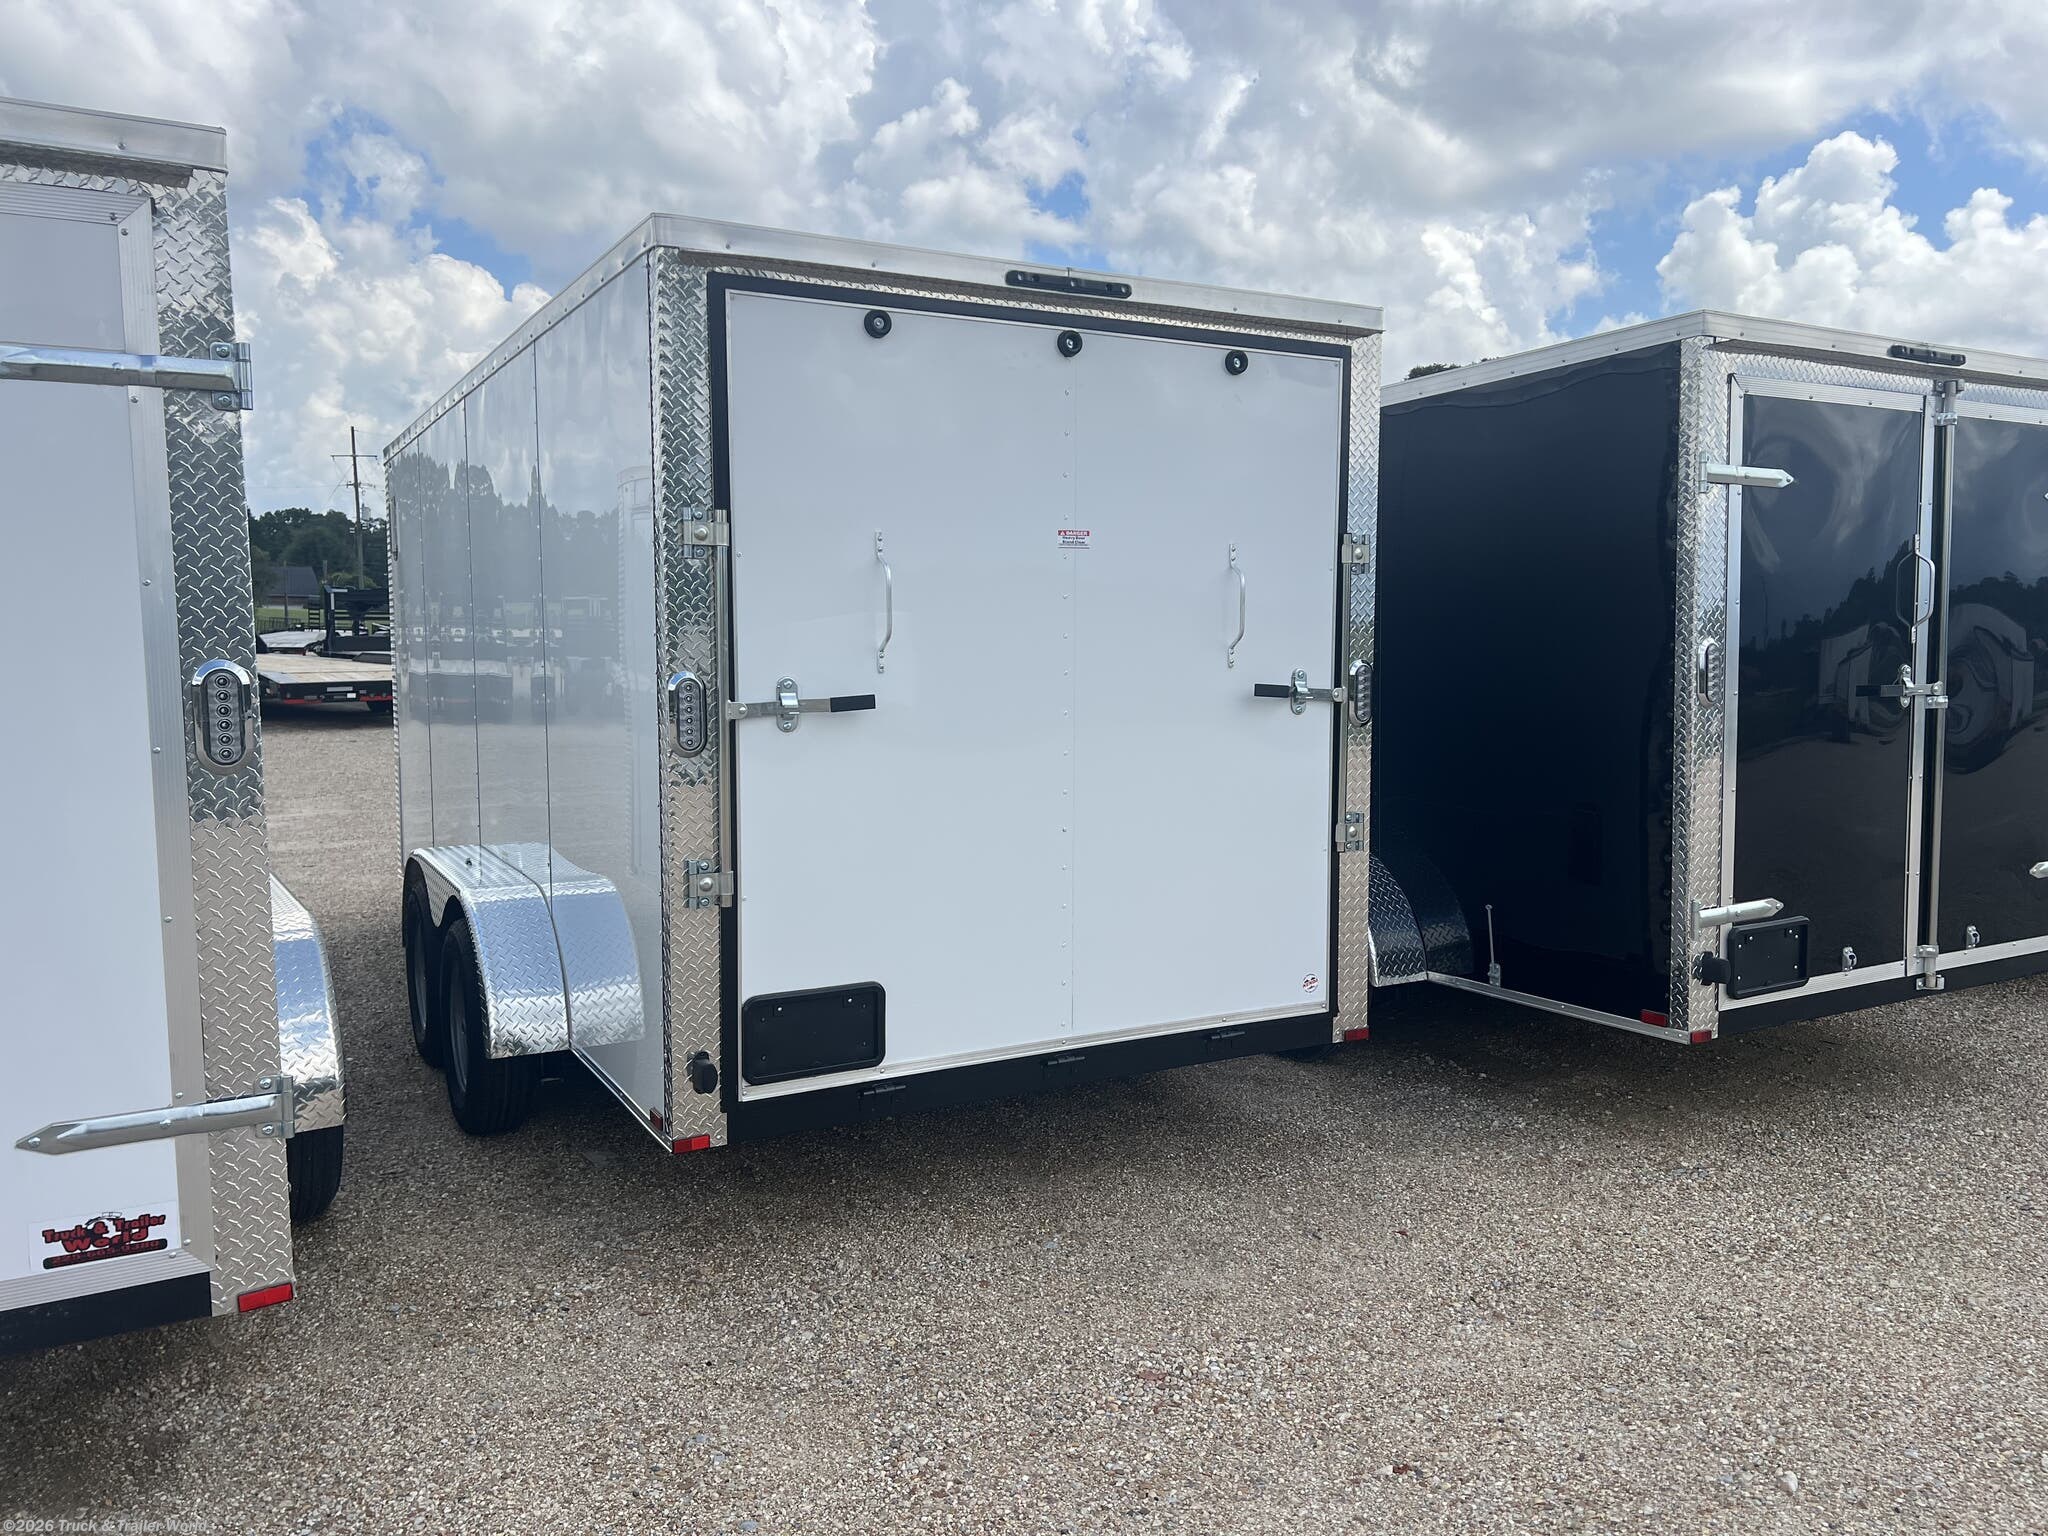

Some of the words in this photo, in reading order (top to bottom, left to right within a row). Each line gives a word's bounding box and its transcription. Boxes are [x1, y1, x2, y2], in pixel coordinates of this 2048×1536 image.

[42, 1225, 86, 1243] Truck
[93, 1221, 109, 1235] &
[113, 1214, 166, 1232] Trailer
[61, 1226, 149, 1253] World
